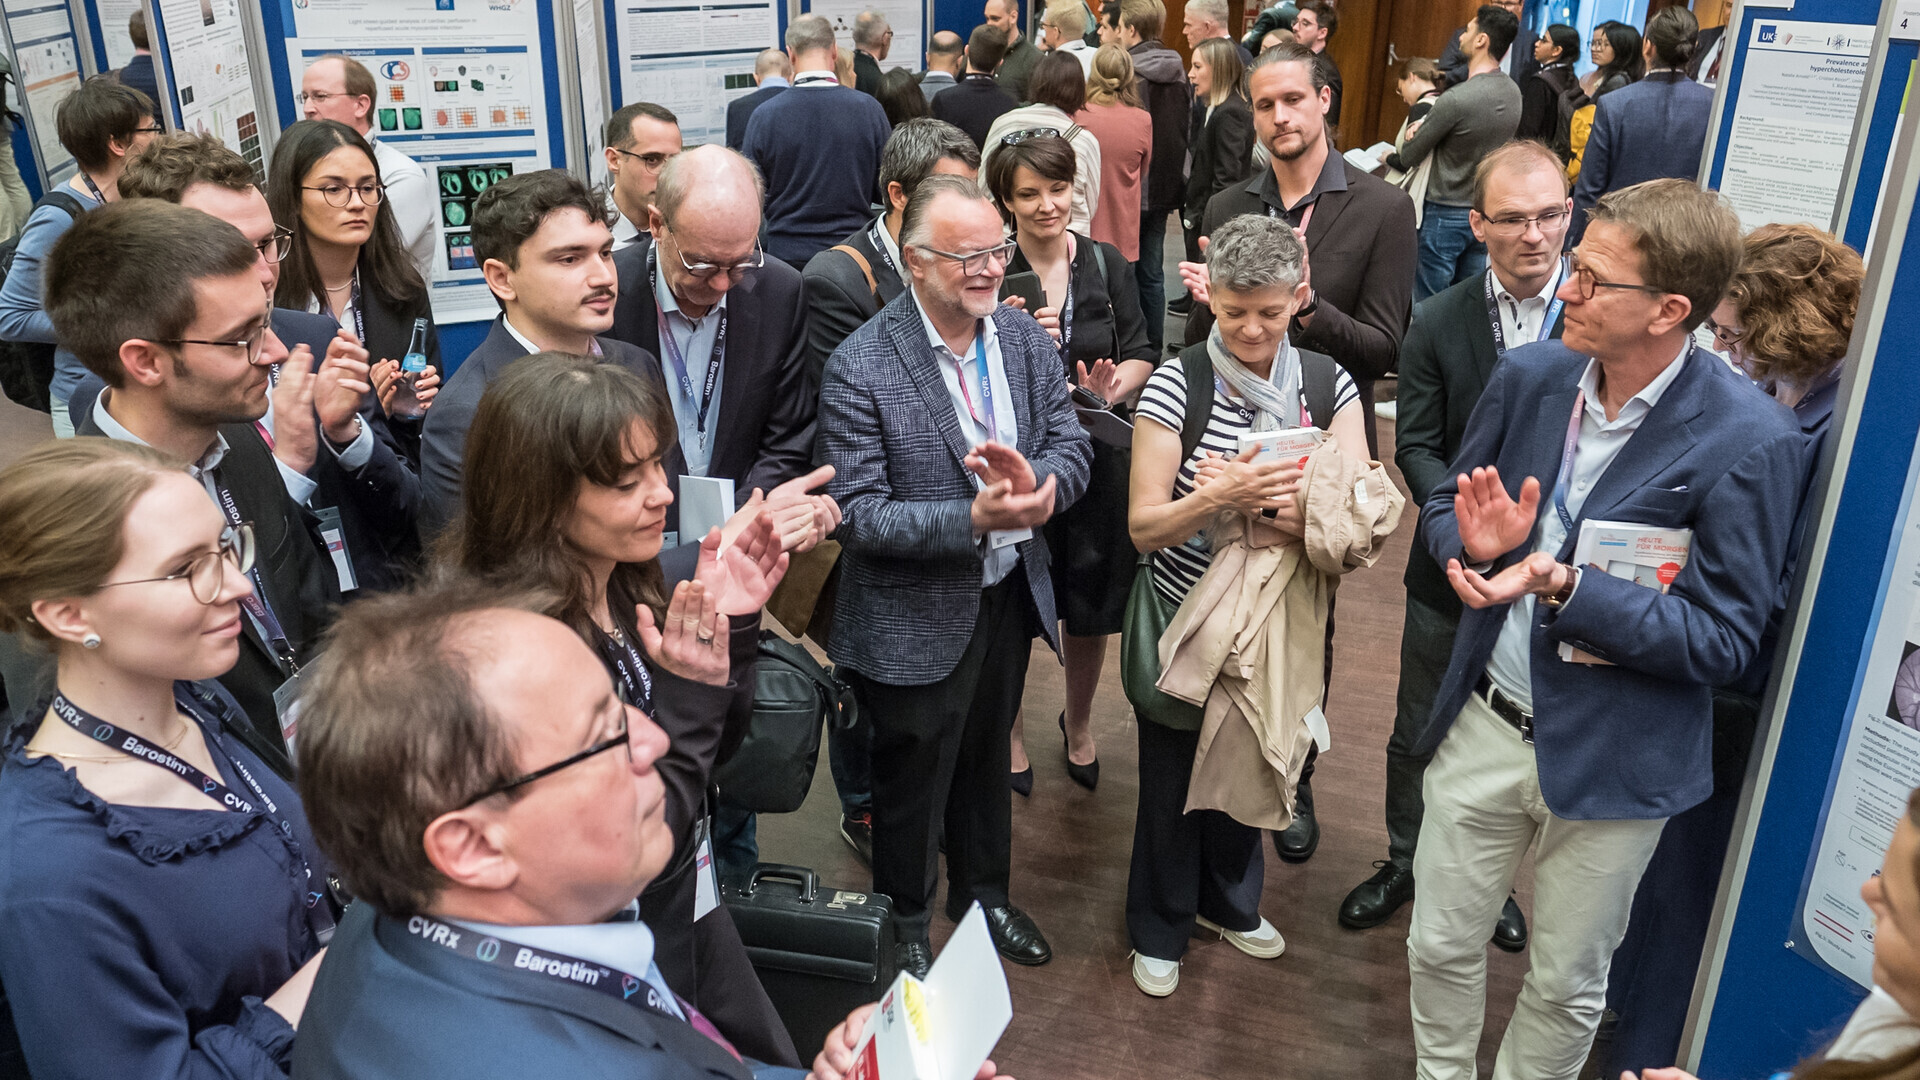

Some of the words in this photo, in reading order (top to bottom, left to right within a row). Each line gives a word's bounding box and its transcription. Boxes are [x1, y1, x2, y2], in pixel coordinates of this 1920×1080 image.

[1900, 18, 1908, 29] 4
[1826, 58, 1860, 67] Prevalence
[1551, 300, 1562, 314] VRx
[717, 318, 728, 340] CVRx
[1492, 322, 1502, 343] CVRx
[681, 375, 693, 397] CVRx
[704, 360, 719, 397] Barostim
[982, 376, 991, 398] CVRx
[1239, 408, 1254, 421] CVR
[1289, 442, 1315, 450] MORGEN
[221, 489, 243, 527] rostim
[1557, 505, 1573, 529] CVRx
[1636, 542, 1652, 550] FÜR
[1653, 544, 1689, 553] MORGEN
[617, 659, 635, 691] CVRx
[53, 696, 84, 727] CVRx
[1862, 734, 1887, 750] included
[1864, 726, 1891, 743] Methods:
[1892, 739, 1903, 748] The
[1903, 746, 1919, 757] study
[1856, 758, 1880, 774] endpoint
[1880, 771, 1892, 780] was
[1858, 751, 1873, 762] using
[1873, 757, 1883, 766] the
[1883, 762, 1911, 780] European
[224, 793, 253, 814] CVR
[408, 915, 461, 949] CVRx
